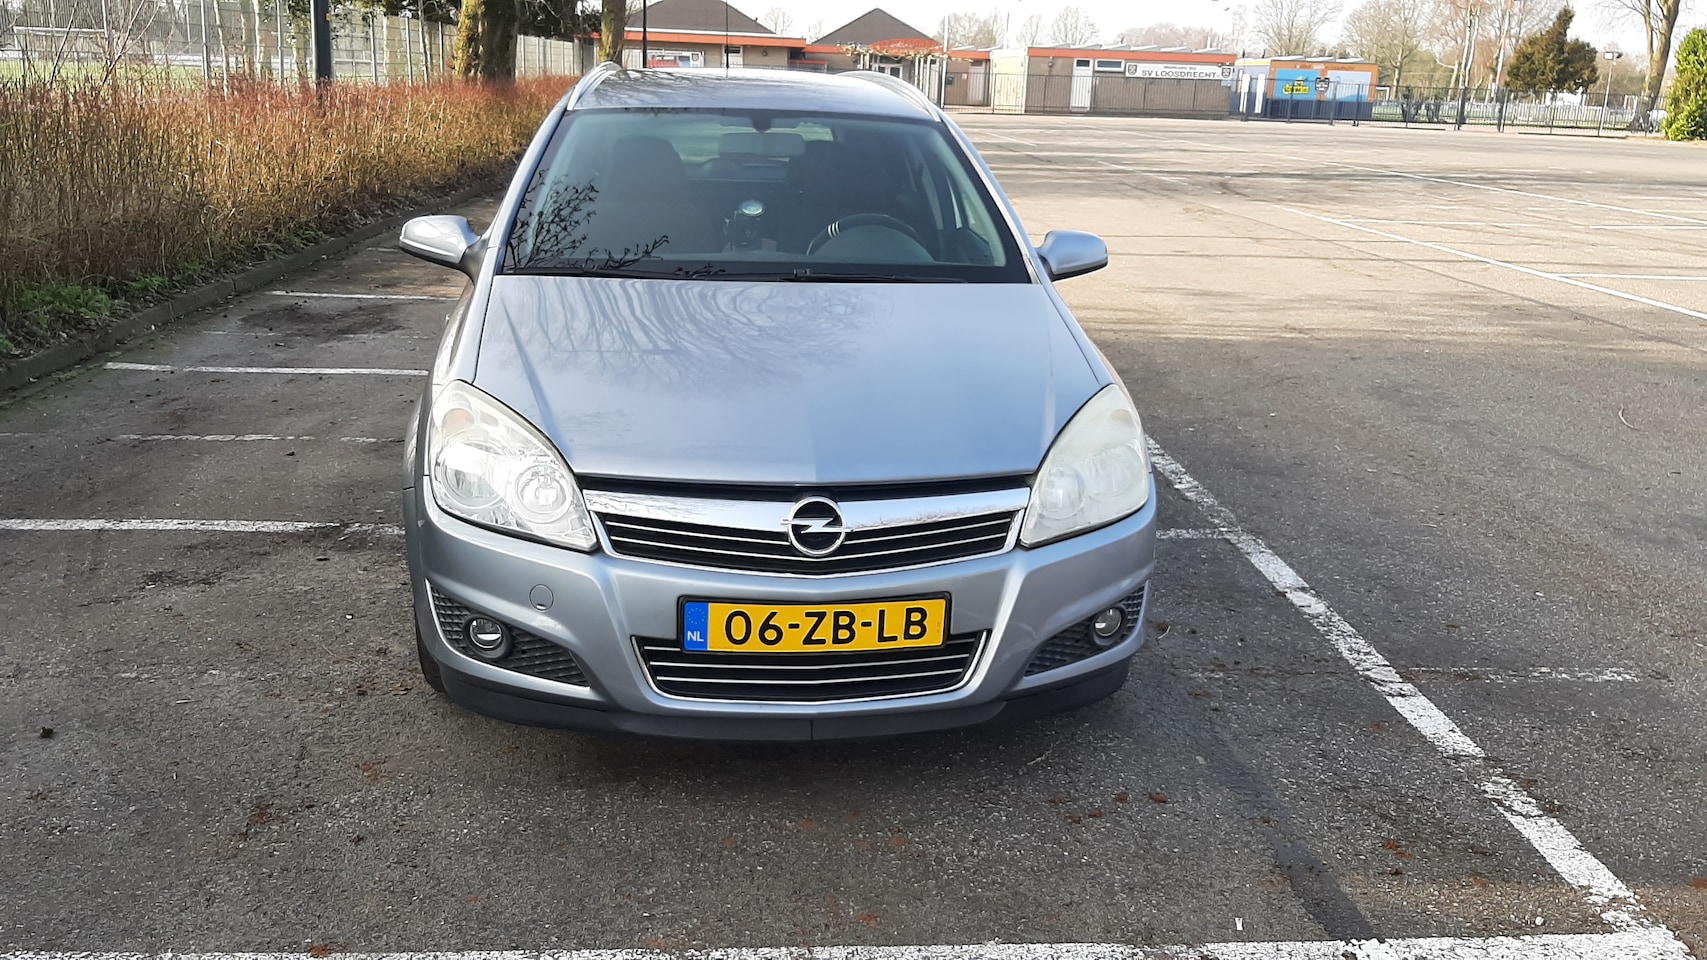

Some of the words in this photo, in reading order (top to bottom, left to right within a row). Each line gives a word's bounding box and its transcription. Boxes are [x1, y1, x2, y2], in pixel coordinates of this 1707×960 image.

[1156, 70, 1217, 78] LOOSDRECHT
[687, 630, 705, 642] NL
[725, 607, 928, 646] 06-ZB-LB
